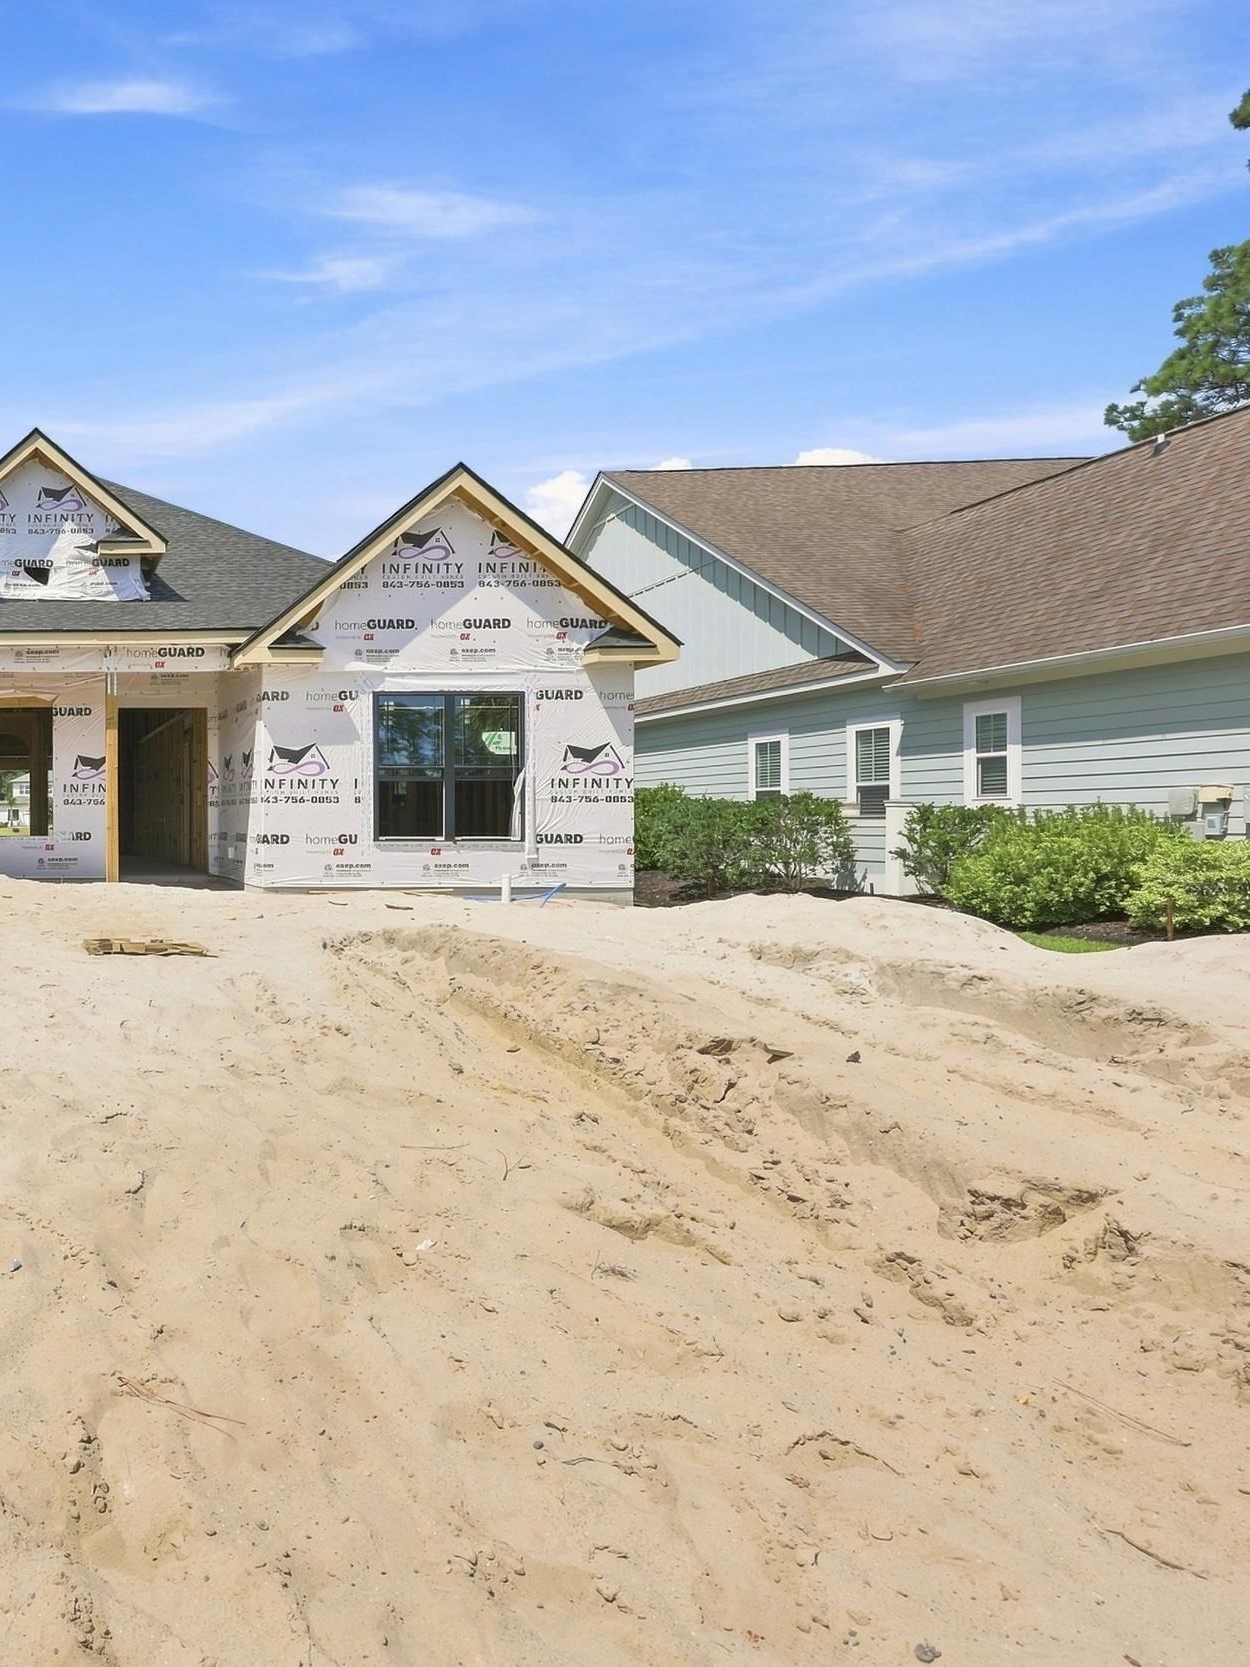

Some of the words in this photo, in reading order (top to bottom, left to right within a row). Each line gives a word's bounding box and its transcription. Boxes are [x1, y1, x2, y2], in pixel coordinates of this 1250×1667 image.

[27, 513, 94, 523] INFINITY
[382, 562, 464, 574] INFINITY
[382, 580, 465, 588] 843-756-0853
[478, 579, 562, 588] 843-756-0853
[334, 618, 415, 630] homeGUARD
[430, 618, 512, 630] homeGUARD
[459, 632, 471, 641] OX
[126, 647, 206, 658] homeGUARD
[535, 689, 584, 700] GUARD
[599, 690, 634, 700] home
[550, 778, 634, 789] INFINITY
[261, 796, 340, 804] 43-756-0853
[550, 795, 634, 803] 843-756-0853
[305, 833, 358, 844] homeGU
[535, 833, 584, 844] GUARD
[599, 833, 634, 845] home
[332, 848, 345, 856] OX
